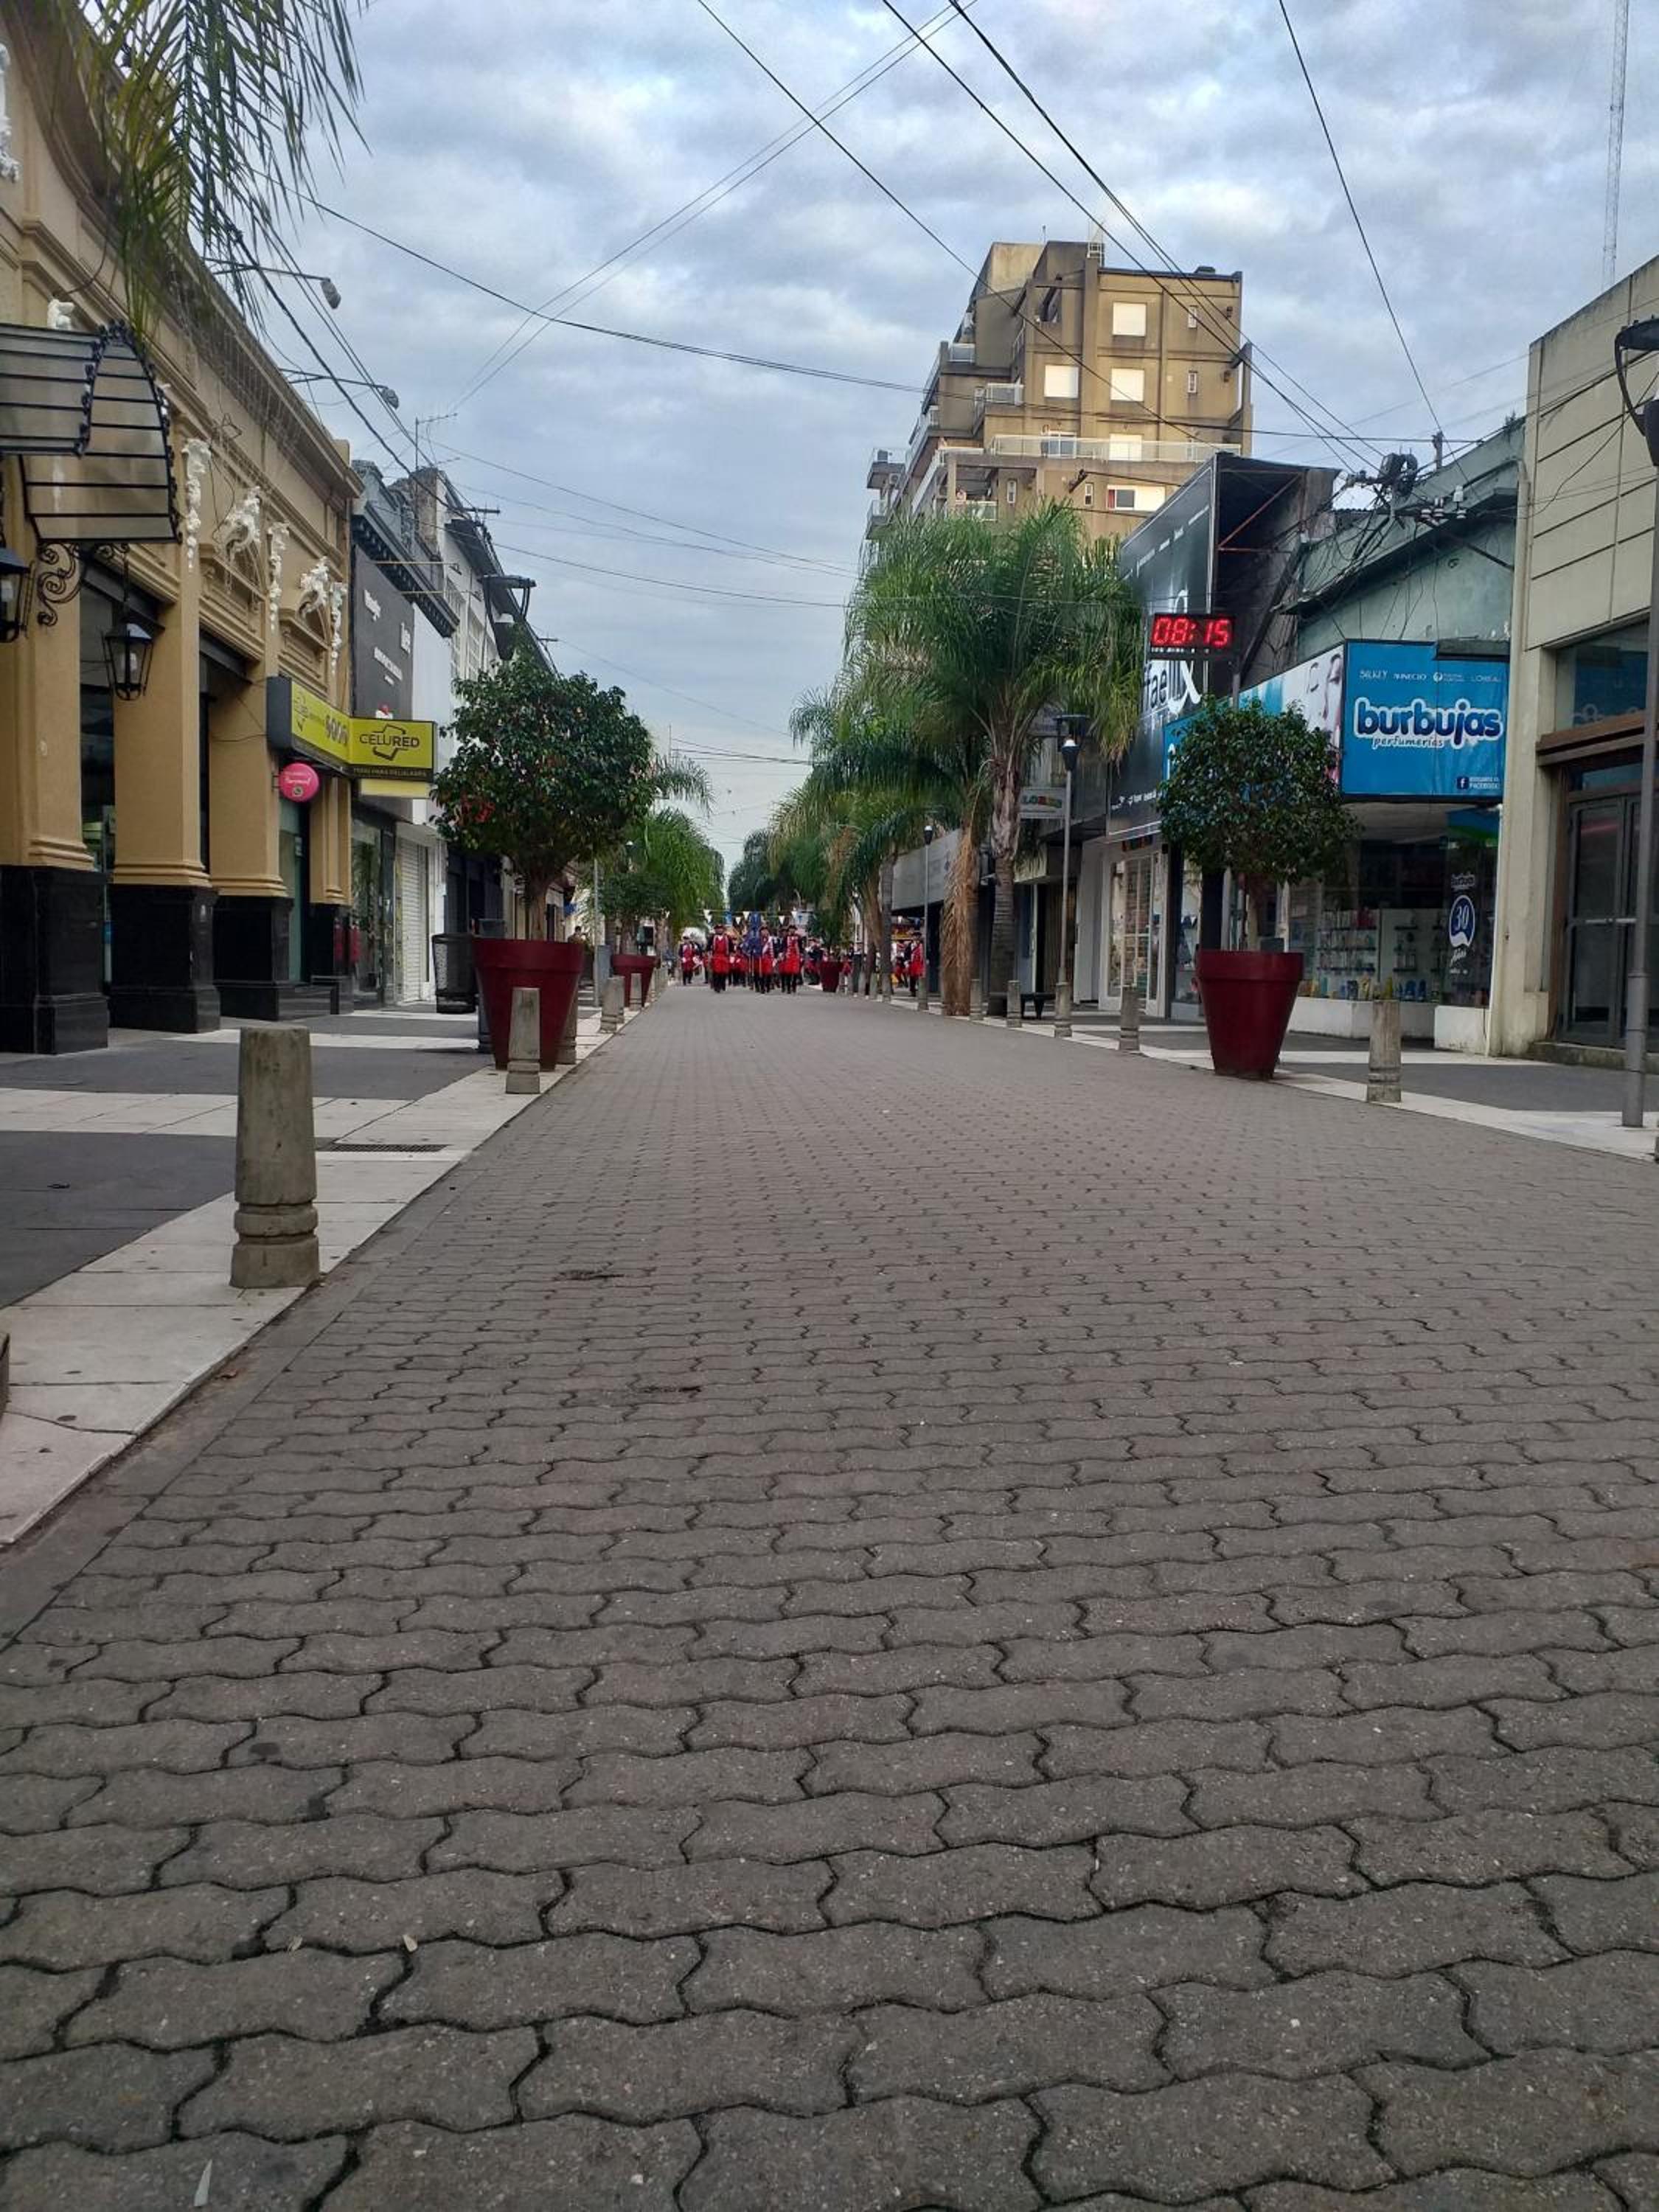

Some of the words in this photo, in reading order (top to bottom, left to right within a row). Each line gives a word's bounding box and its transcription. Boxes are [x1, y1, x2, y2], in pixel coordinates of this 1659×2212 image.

[1150, 616, 1230, 648] 08:15
[1354, 698, 1503, 749] burbujas
[359, 734, 420, 748] CELURED
